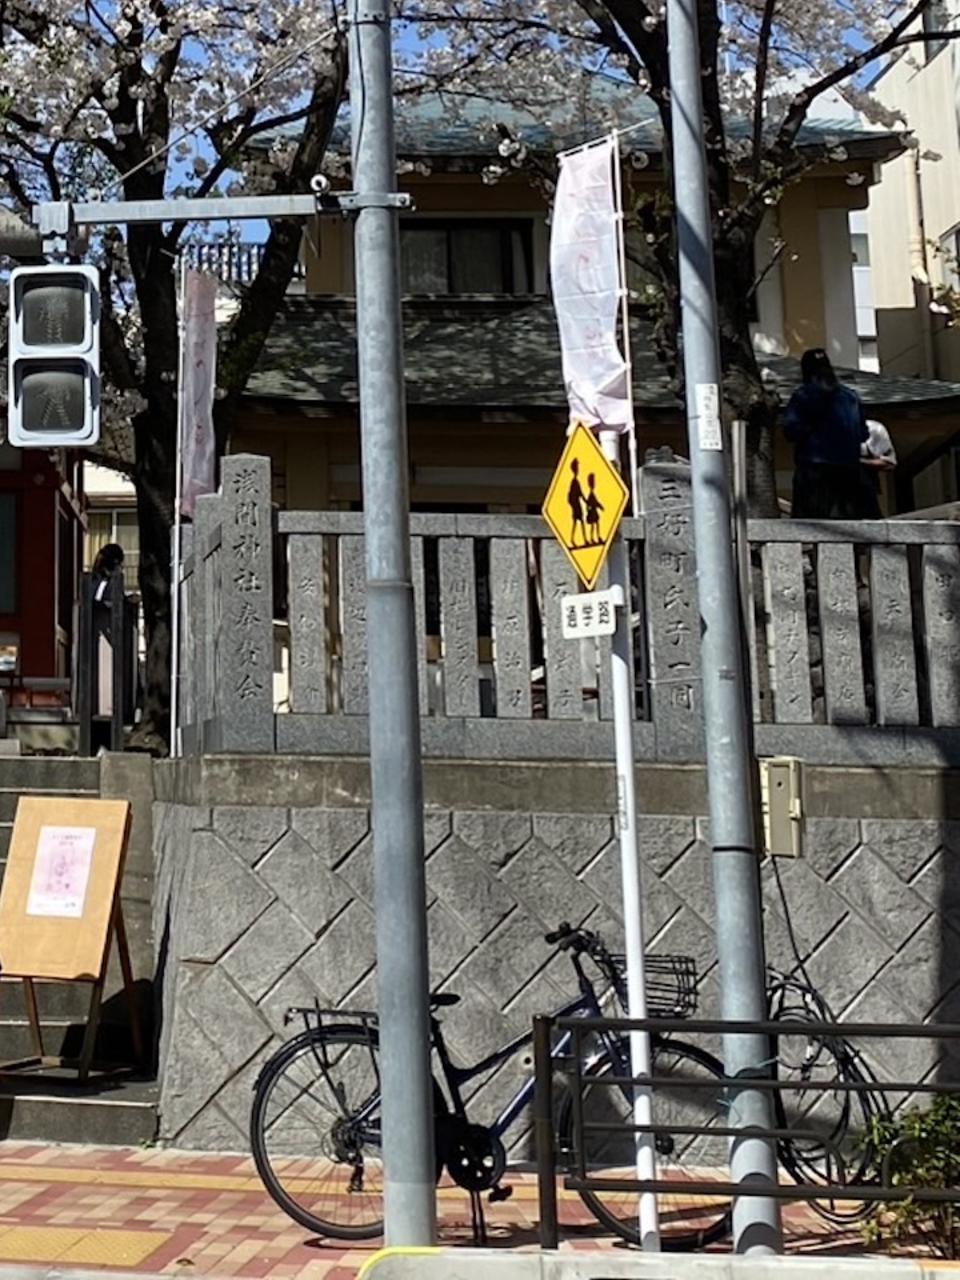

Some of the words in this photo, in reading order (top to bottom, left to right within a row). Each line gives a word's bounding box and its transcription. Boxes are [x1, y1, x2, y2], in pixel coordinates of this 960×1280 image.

[655, 479, 695, 710] 三好町氏子一同
